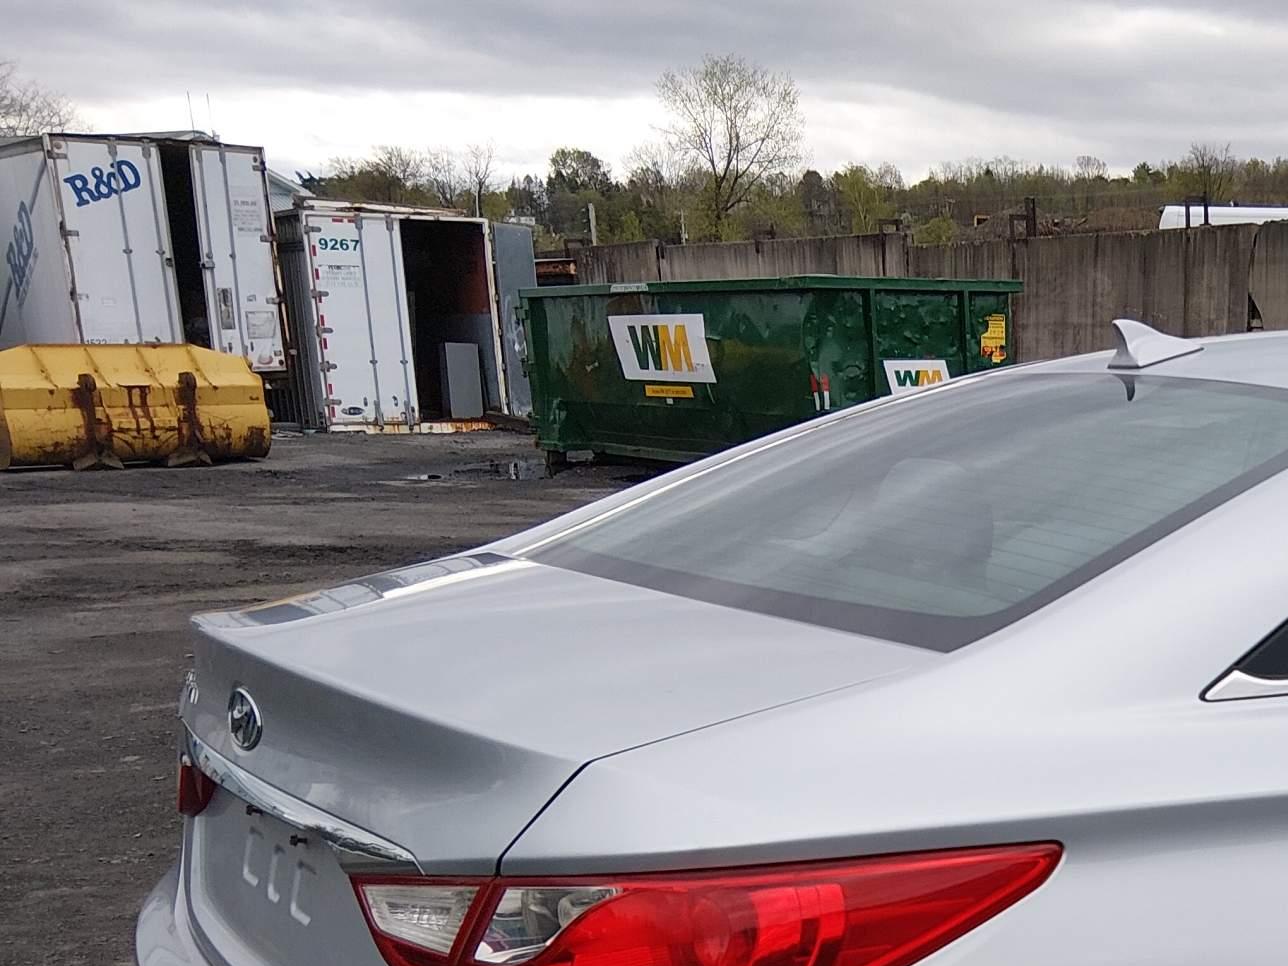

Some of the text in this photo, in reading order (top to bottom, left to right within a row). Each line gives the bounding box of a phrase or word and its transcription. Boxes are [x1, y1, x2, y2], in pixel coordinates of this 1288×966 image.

[63, 159, 141, 207] R&D
[318, 237, 360, 251] 9267
[626, 324, 695, 372] WM
[893, 369, 943, 387] WM
